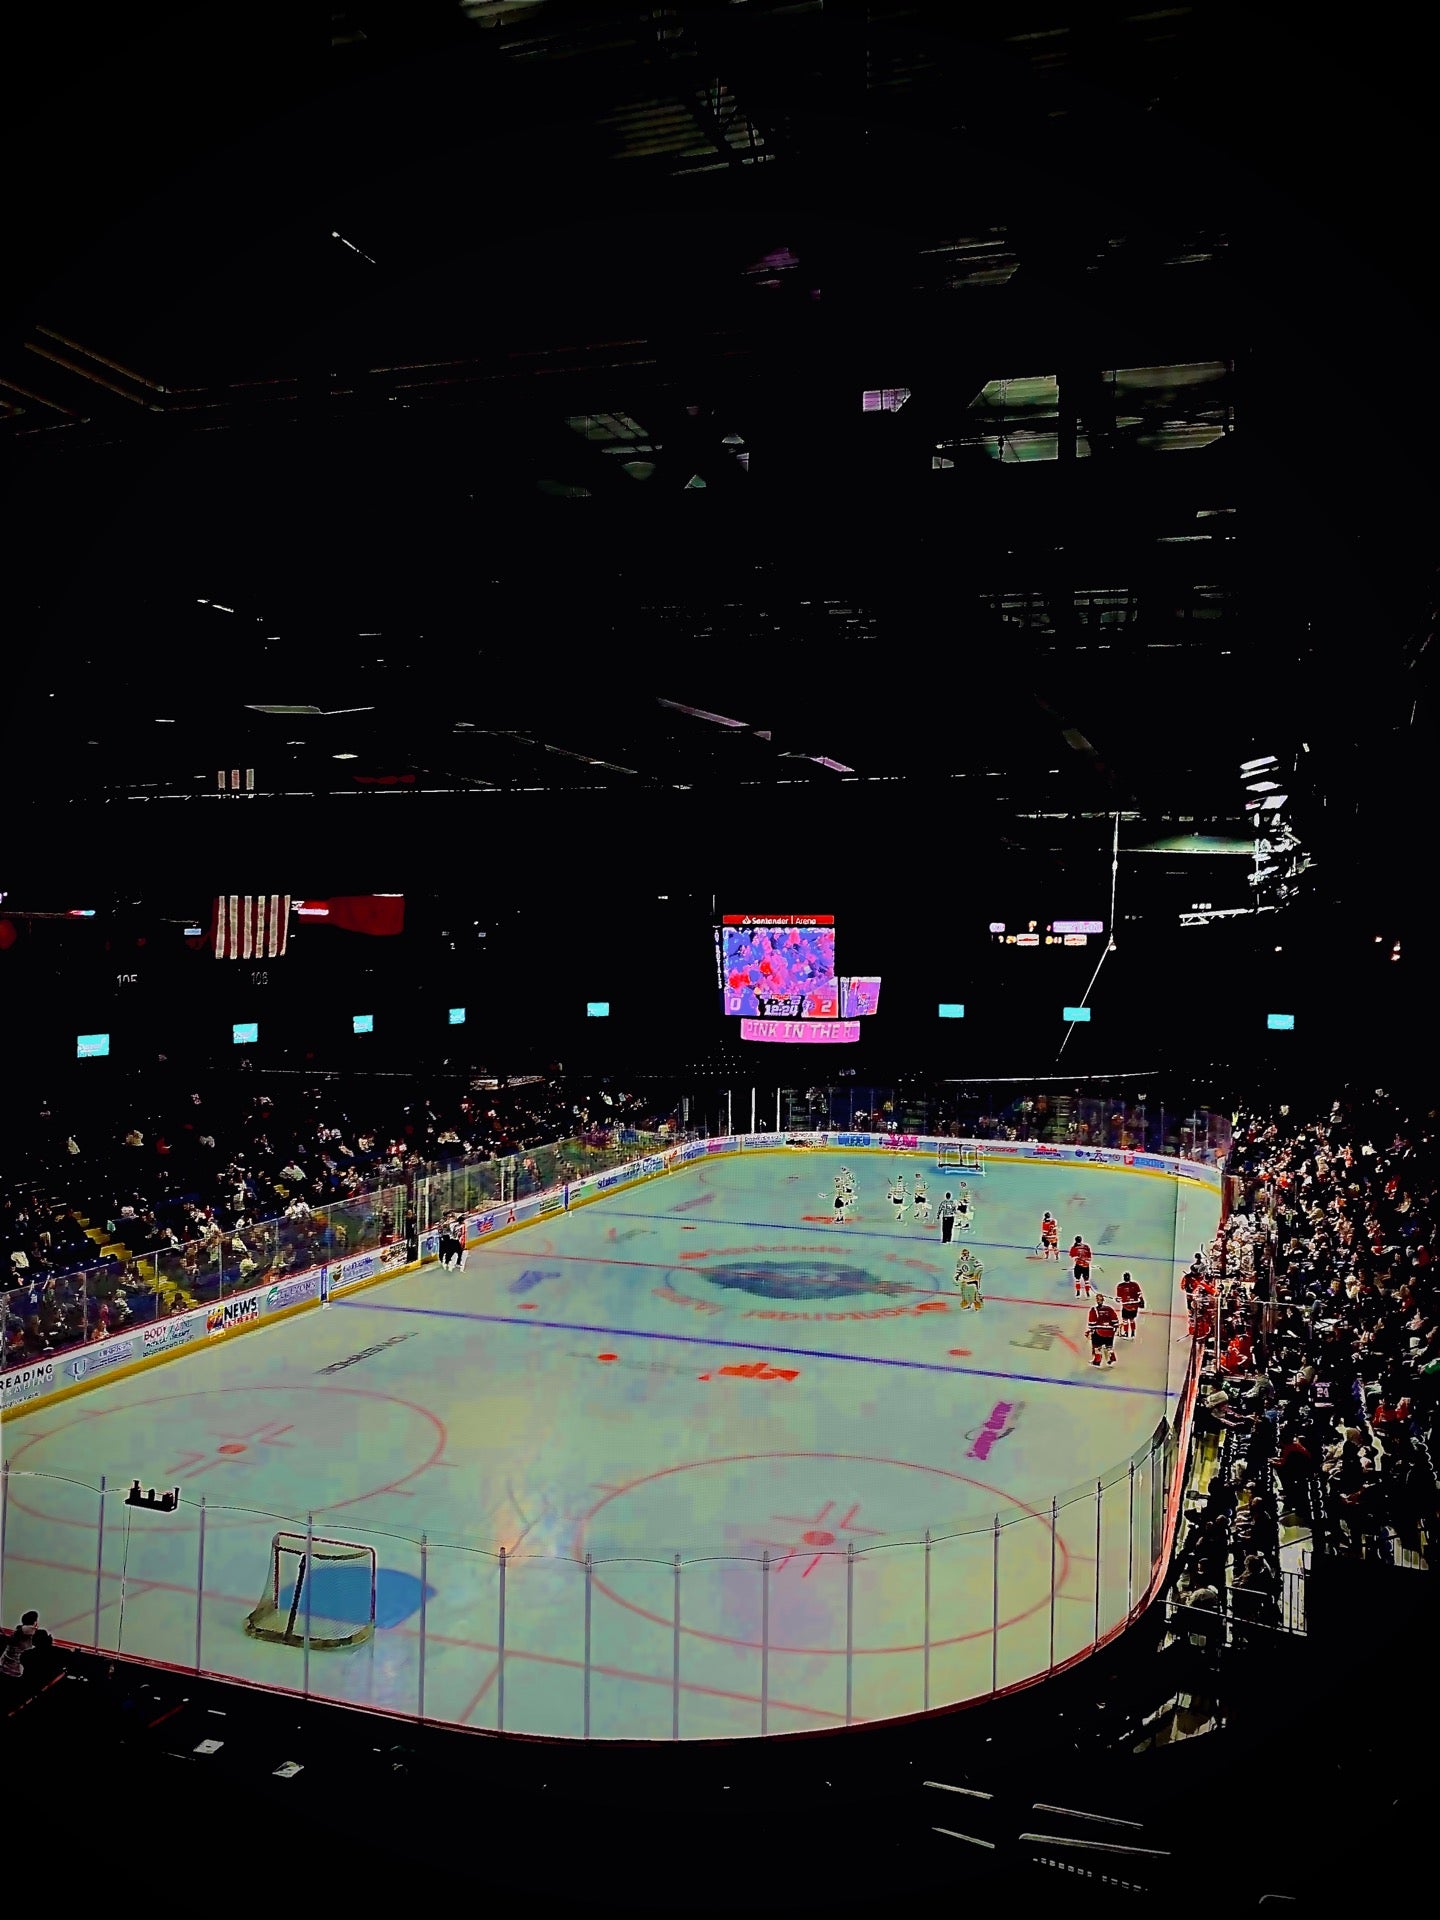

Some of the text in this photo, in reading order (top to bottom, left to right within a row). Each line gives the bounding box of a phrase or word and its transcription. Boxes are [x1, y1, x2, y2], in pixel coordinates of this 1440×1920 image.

[751, 917, 817, 925] Santander Arena
[729, 997, 742, 1011] 0
[820, 999, 833, 1013] 2
[784, 1022, 806, 1039] IN
[810, 1023, 841, 1039] THE
[224, 1296, 257, 1322] NEWS
[144, 1325, 166, 1341] BODY
